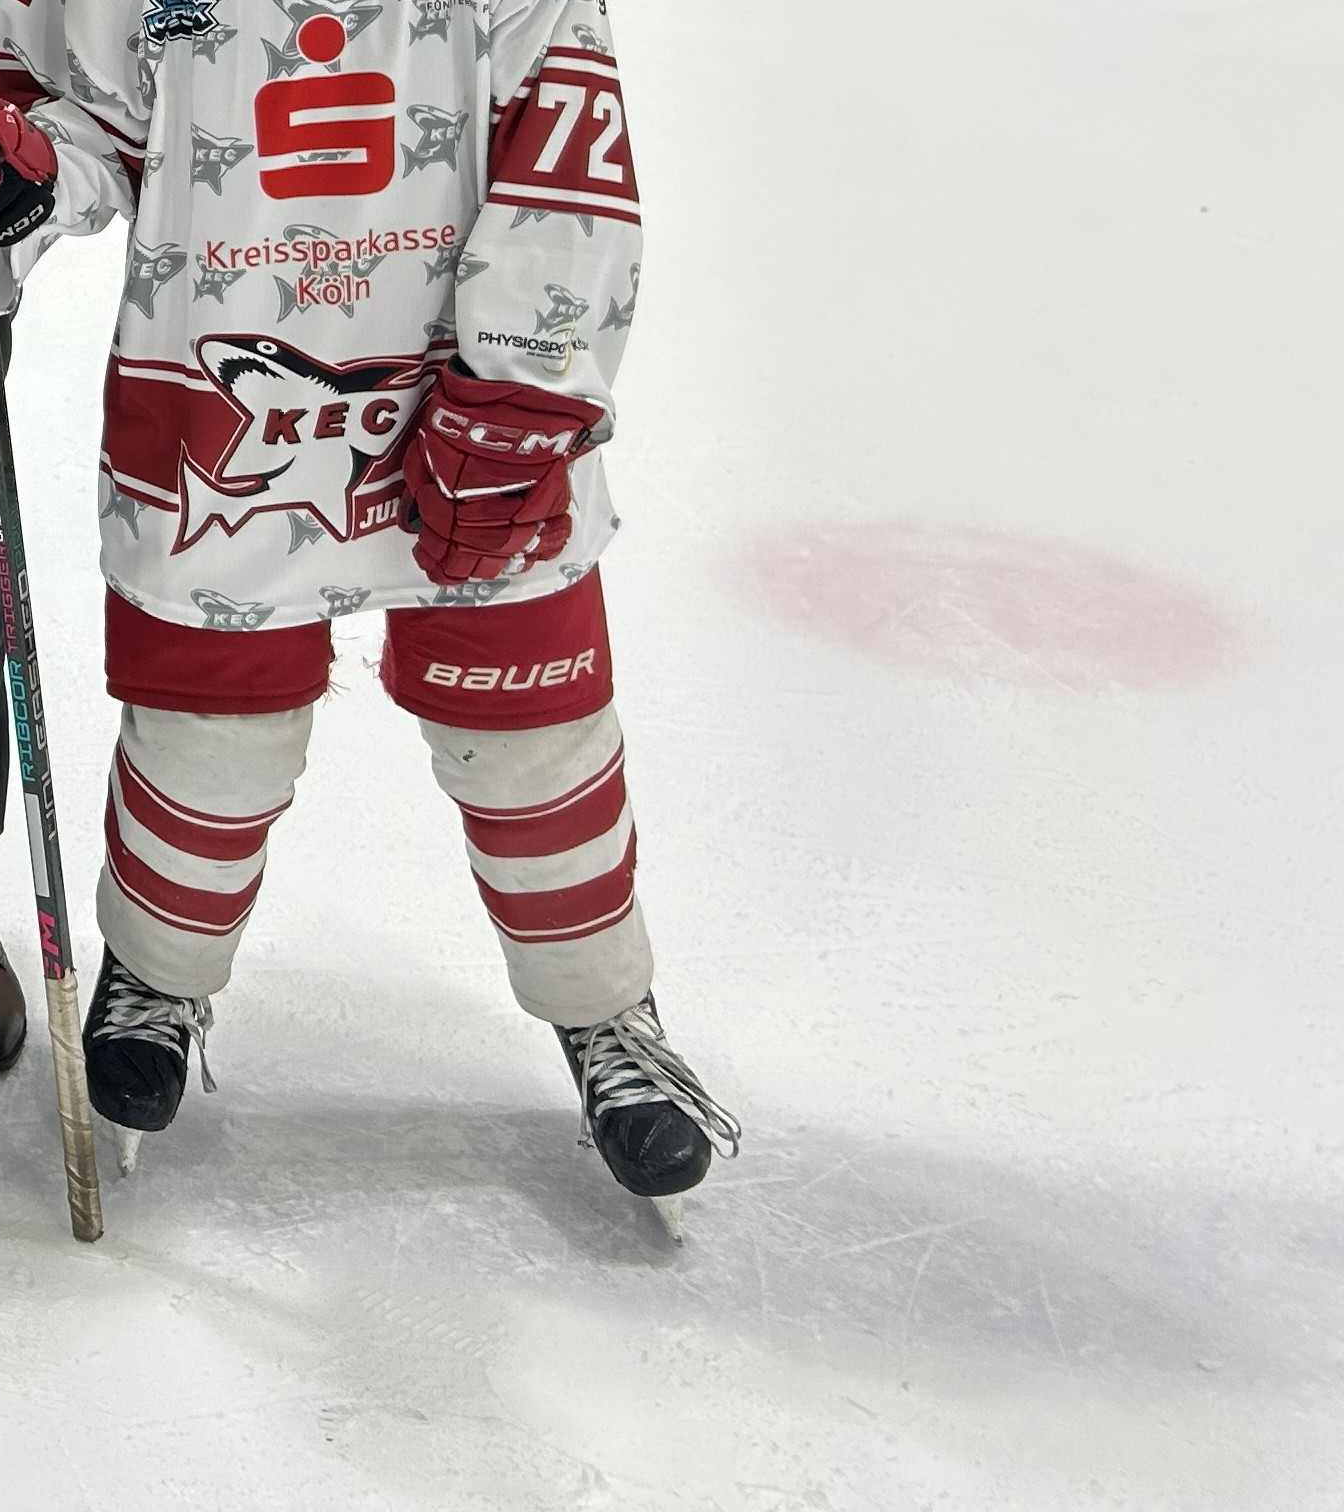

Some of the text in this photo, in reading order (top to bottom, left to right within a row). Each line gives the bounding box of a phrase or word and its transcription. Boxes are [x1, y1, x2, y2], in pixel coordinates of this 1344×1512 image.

[195, 148, 237, 162] KEC
[534, 82, 625, 184] 72
[205, 223, 457, 269] Kreissparkasse
[296, 277, 371, 306] Köln
[262, 399, 400, 446] KEC
[431, 407, 576, 456] CCM
[8, 660, 36, 781] RIBCOR
